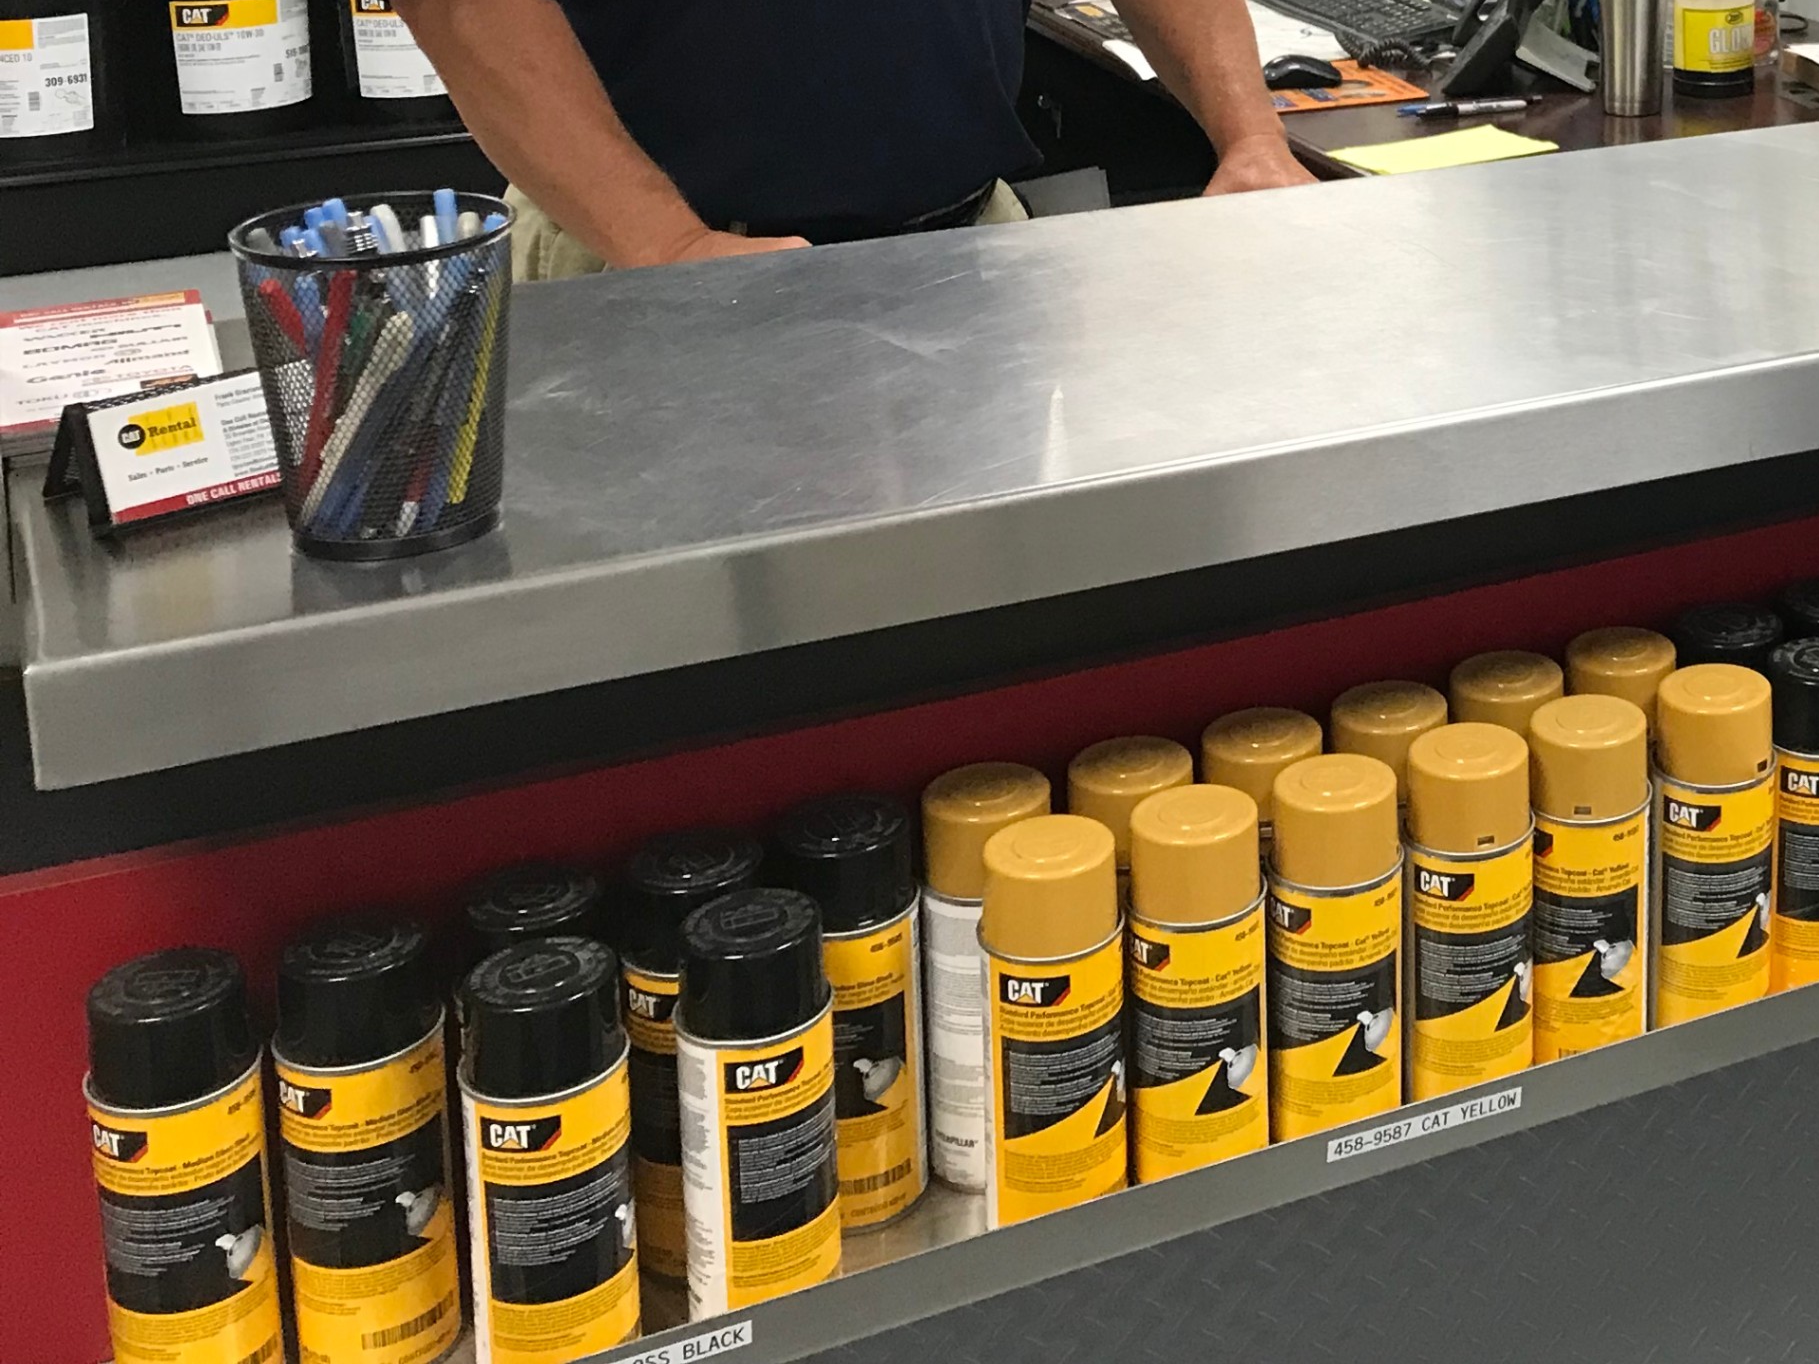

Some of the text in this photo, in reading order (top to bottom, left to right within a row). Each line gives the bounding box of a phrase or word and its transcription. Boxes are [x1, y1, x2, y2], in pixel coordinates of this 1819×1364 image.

[182, 8, 211, 24] CAT
[45, 74, 88, 87] 309-6931
[147, 417, 198, 438] Rental
[128, 457, 209, 482] Sales Parts Service
[186, 484, 237, 505] ONE CALL
[1669, 802, 1700, 828] CAT
[1420, 870, 1451, 897] CAT
[1560, 867, 1587, 880] Topcoat
[1592, 867, 1608, 877] Cat
[1438, 903, 1482, 912] Performance
[1321, 928, 1390, 952] Topcoat Cat Yellow
[1180, 963, 1252, 988] Topcoat Cat Yellow
[628, 989, 658, 1019] CAT
[1007, 979, 1046, 1004] CAT
[1030, 1007, 1079, 1020] Performance
[736, 1062, 780, 1090] CAT
[279, 1080, 306, 1113] CAT
[489, 1124, 532, 1149] CAT
[1334, 1092, 1517, 1157] 458-9587 CAT YELLOW
[93, 1124, 123, 1157] CAT
[510, 1154, 557, 1165] Performance
[682, 1327, 746, 1360] BLACK
